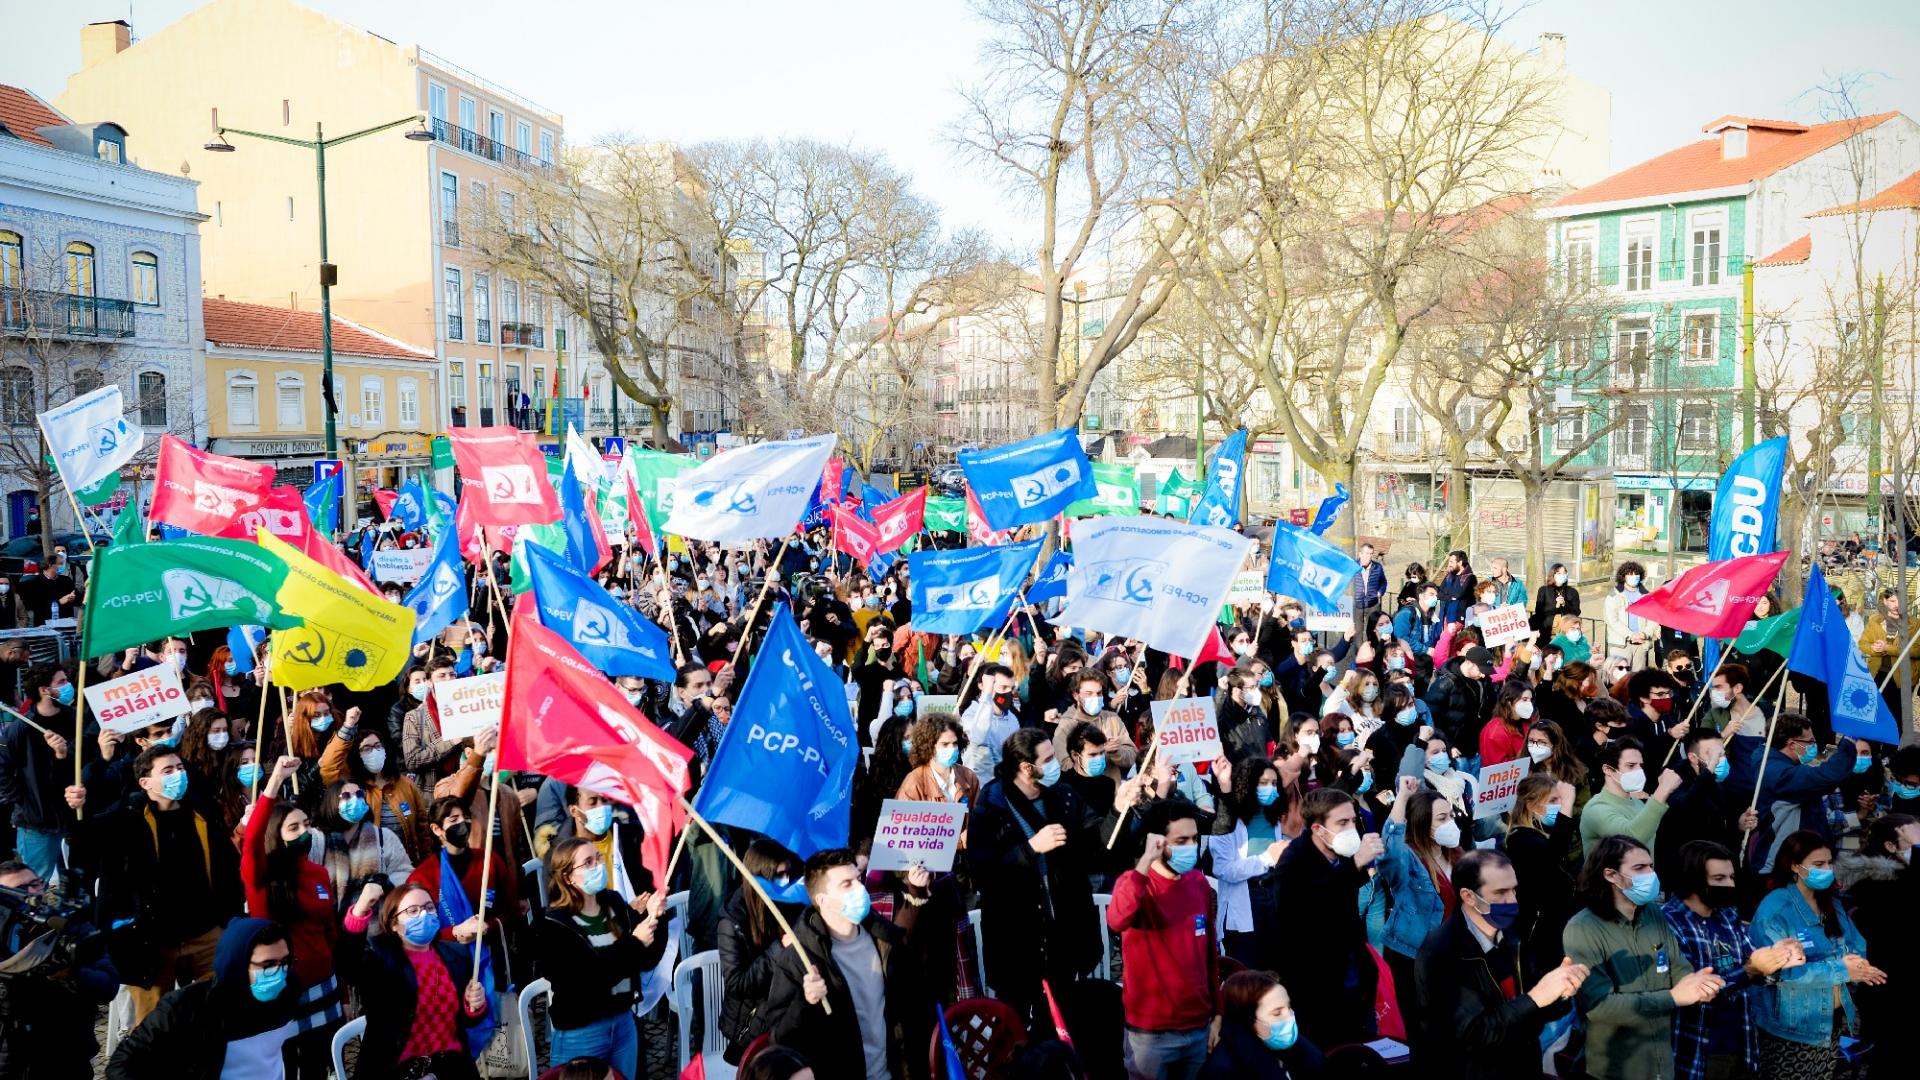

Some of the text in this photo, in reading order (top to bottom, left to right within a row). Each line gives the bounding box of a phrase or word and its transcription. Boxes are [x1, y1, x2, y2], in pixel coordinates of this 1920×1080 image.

[981, 490, 1013, 501] PCP-PEV
[1730, 475, 1768, 558] CDU
[317, 579, 364, 608] DEMOCRÁTICA
[1231, 584, 1262, 592] ducação
[1488, 609, 1518, 625] mais
[1485, 619, 1528, 638] salário
[104, 674, 161, 702] mais
[100, 687, 180, 722] salário
[443, 702, 454, 717] à
[1165, 703, 1205, 724] mais
[1160, 722, 1216, 746] salário
[1488, 765, 1521, 785] mais
[1479, 778, 1519, 803] salári
[891, 809, 953, 824] igualdade
[882, 825, 955, 837] no trabalho
[887, 838, 944, 850] e na vida
